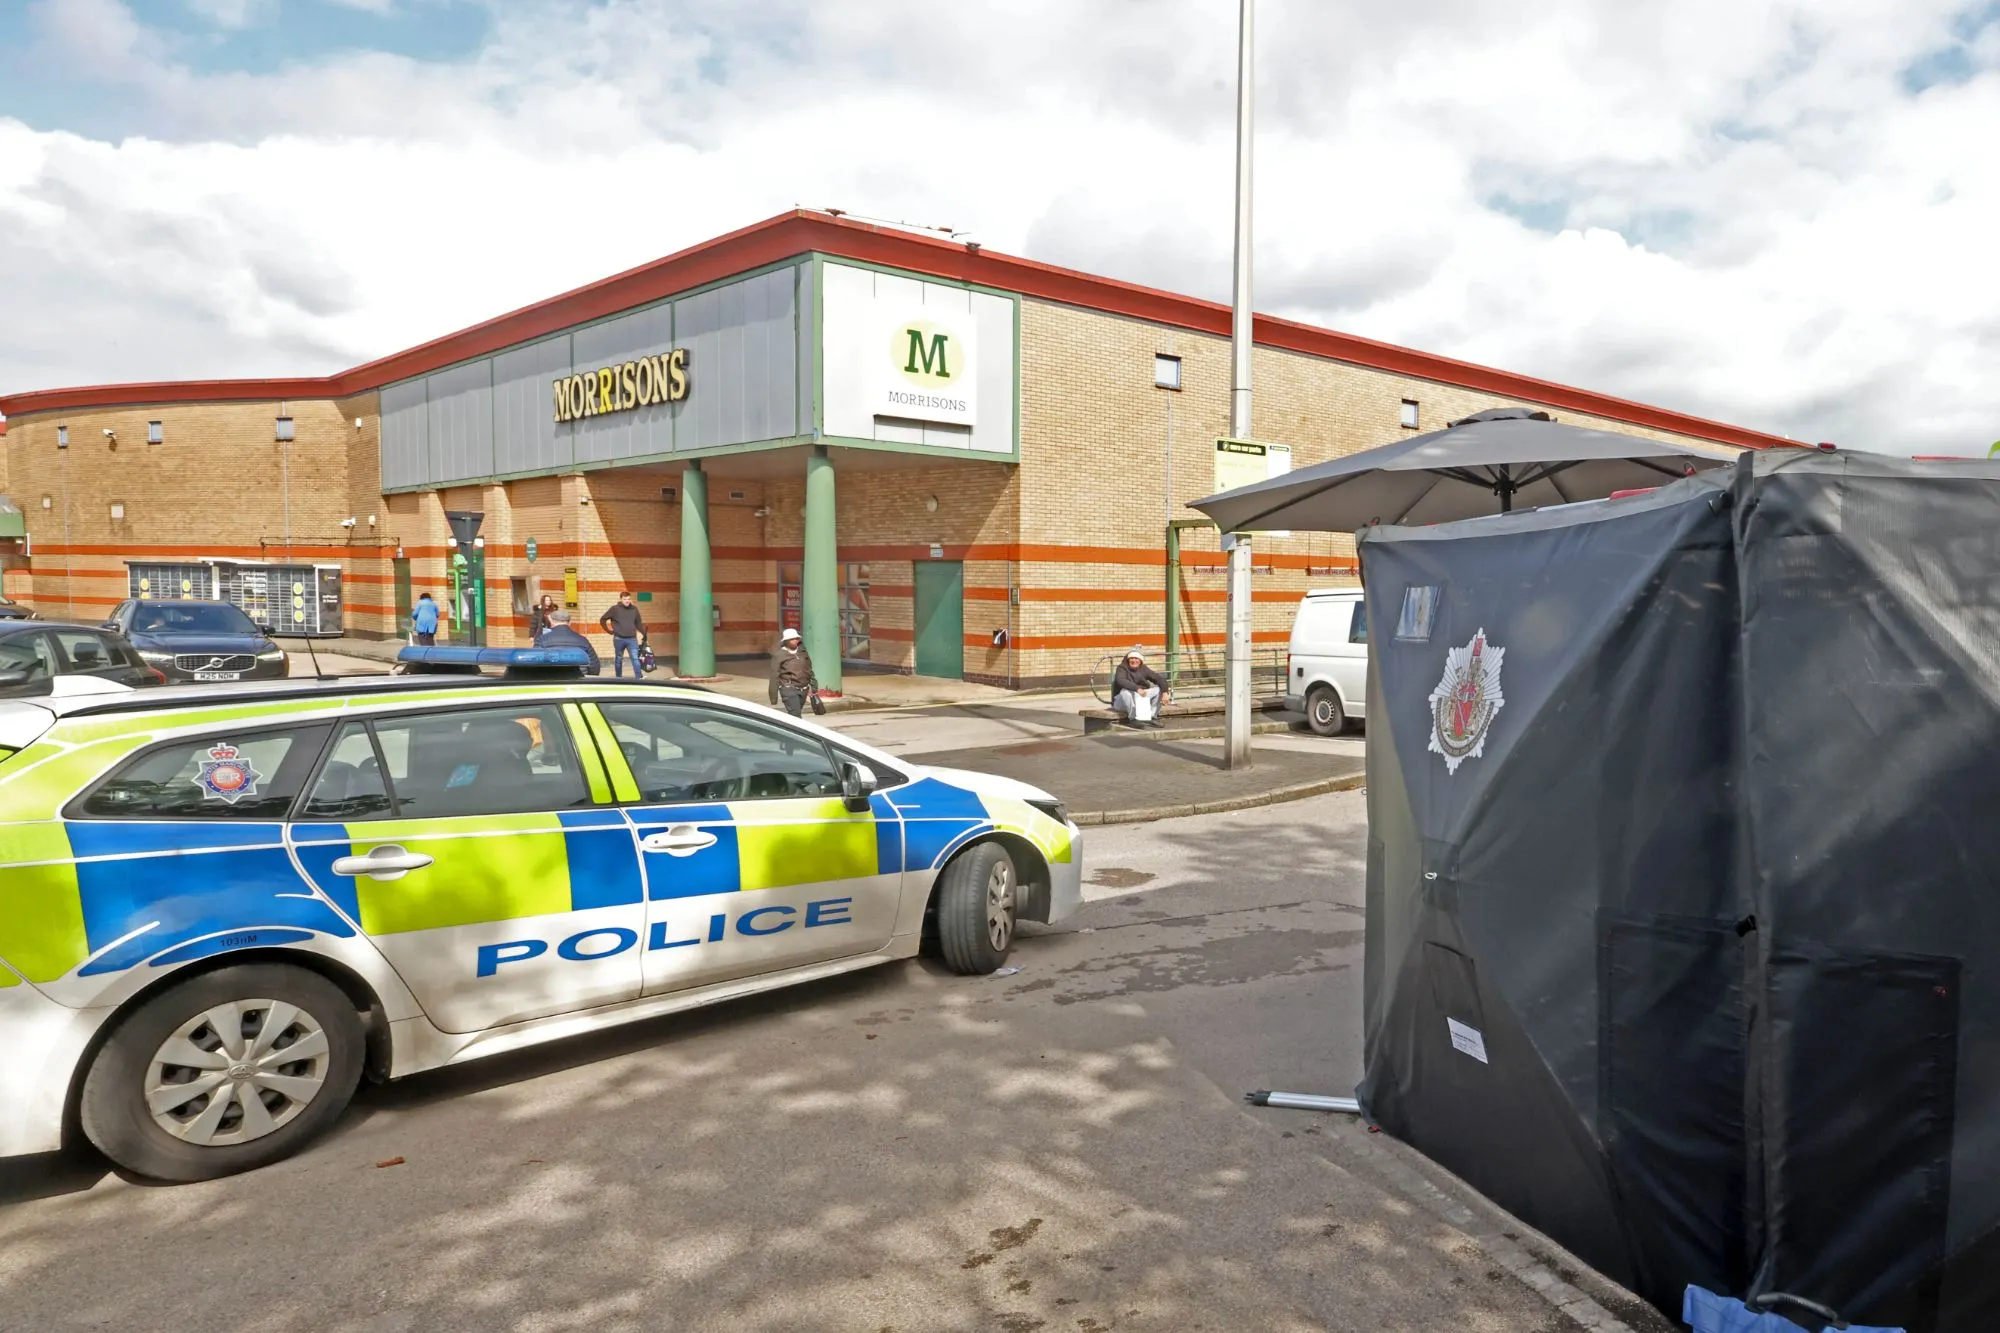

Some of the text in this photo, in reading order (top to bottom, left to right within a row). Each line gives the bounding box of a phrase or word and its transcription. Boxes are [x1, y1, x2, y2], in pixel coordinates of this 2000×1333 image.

[904, 329, 950, 378] M
[552, 348, 690, 422] MORRISONS
[888, 390, 966, 411] MORRISONS
[477, 897, 852, 977] POLICE
